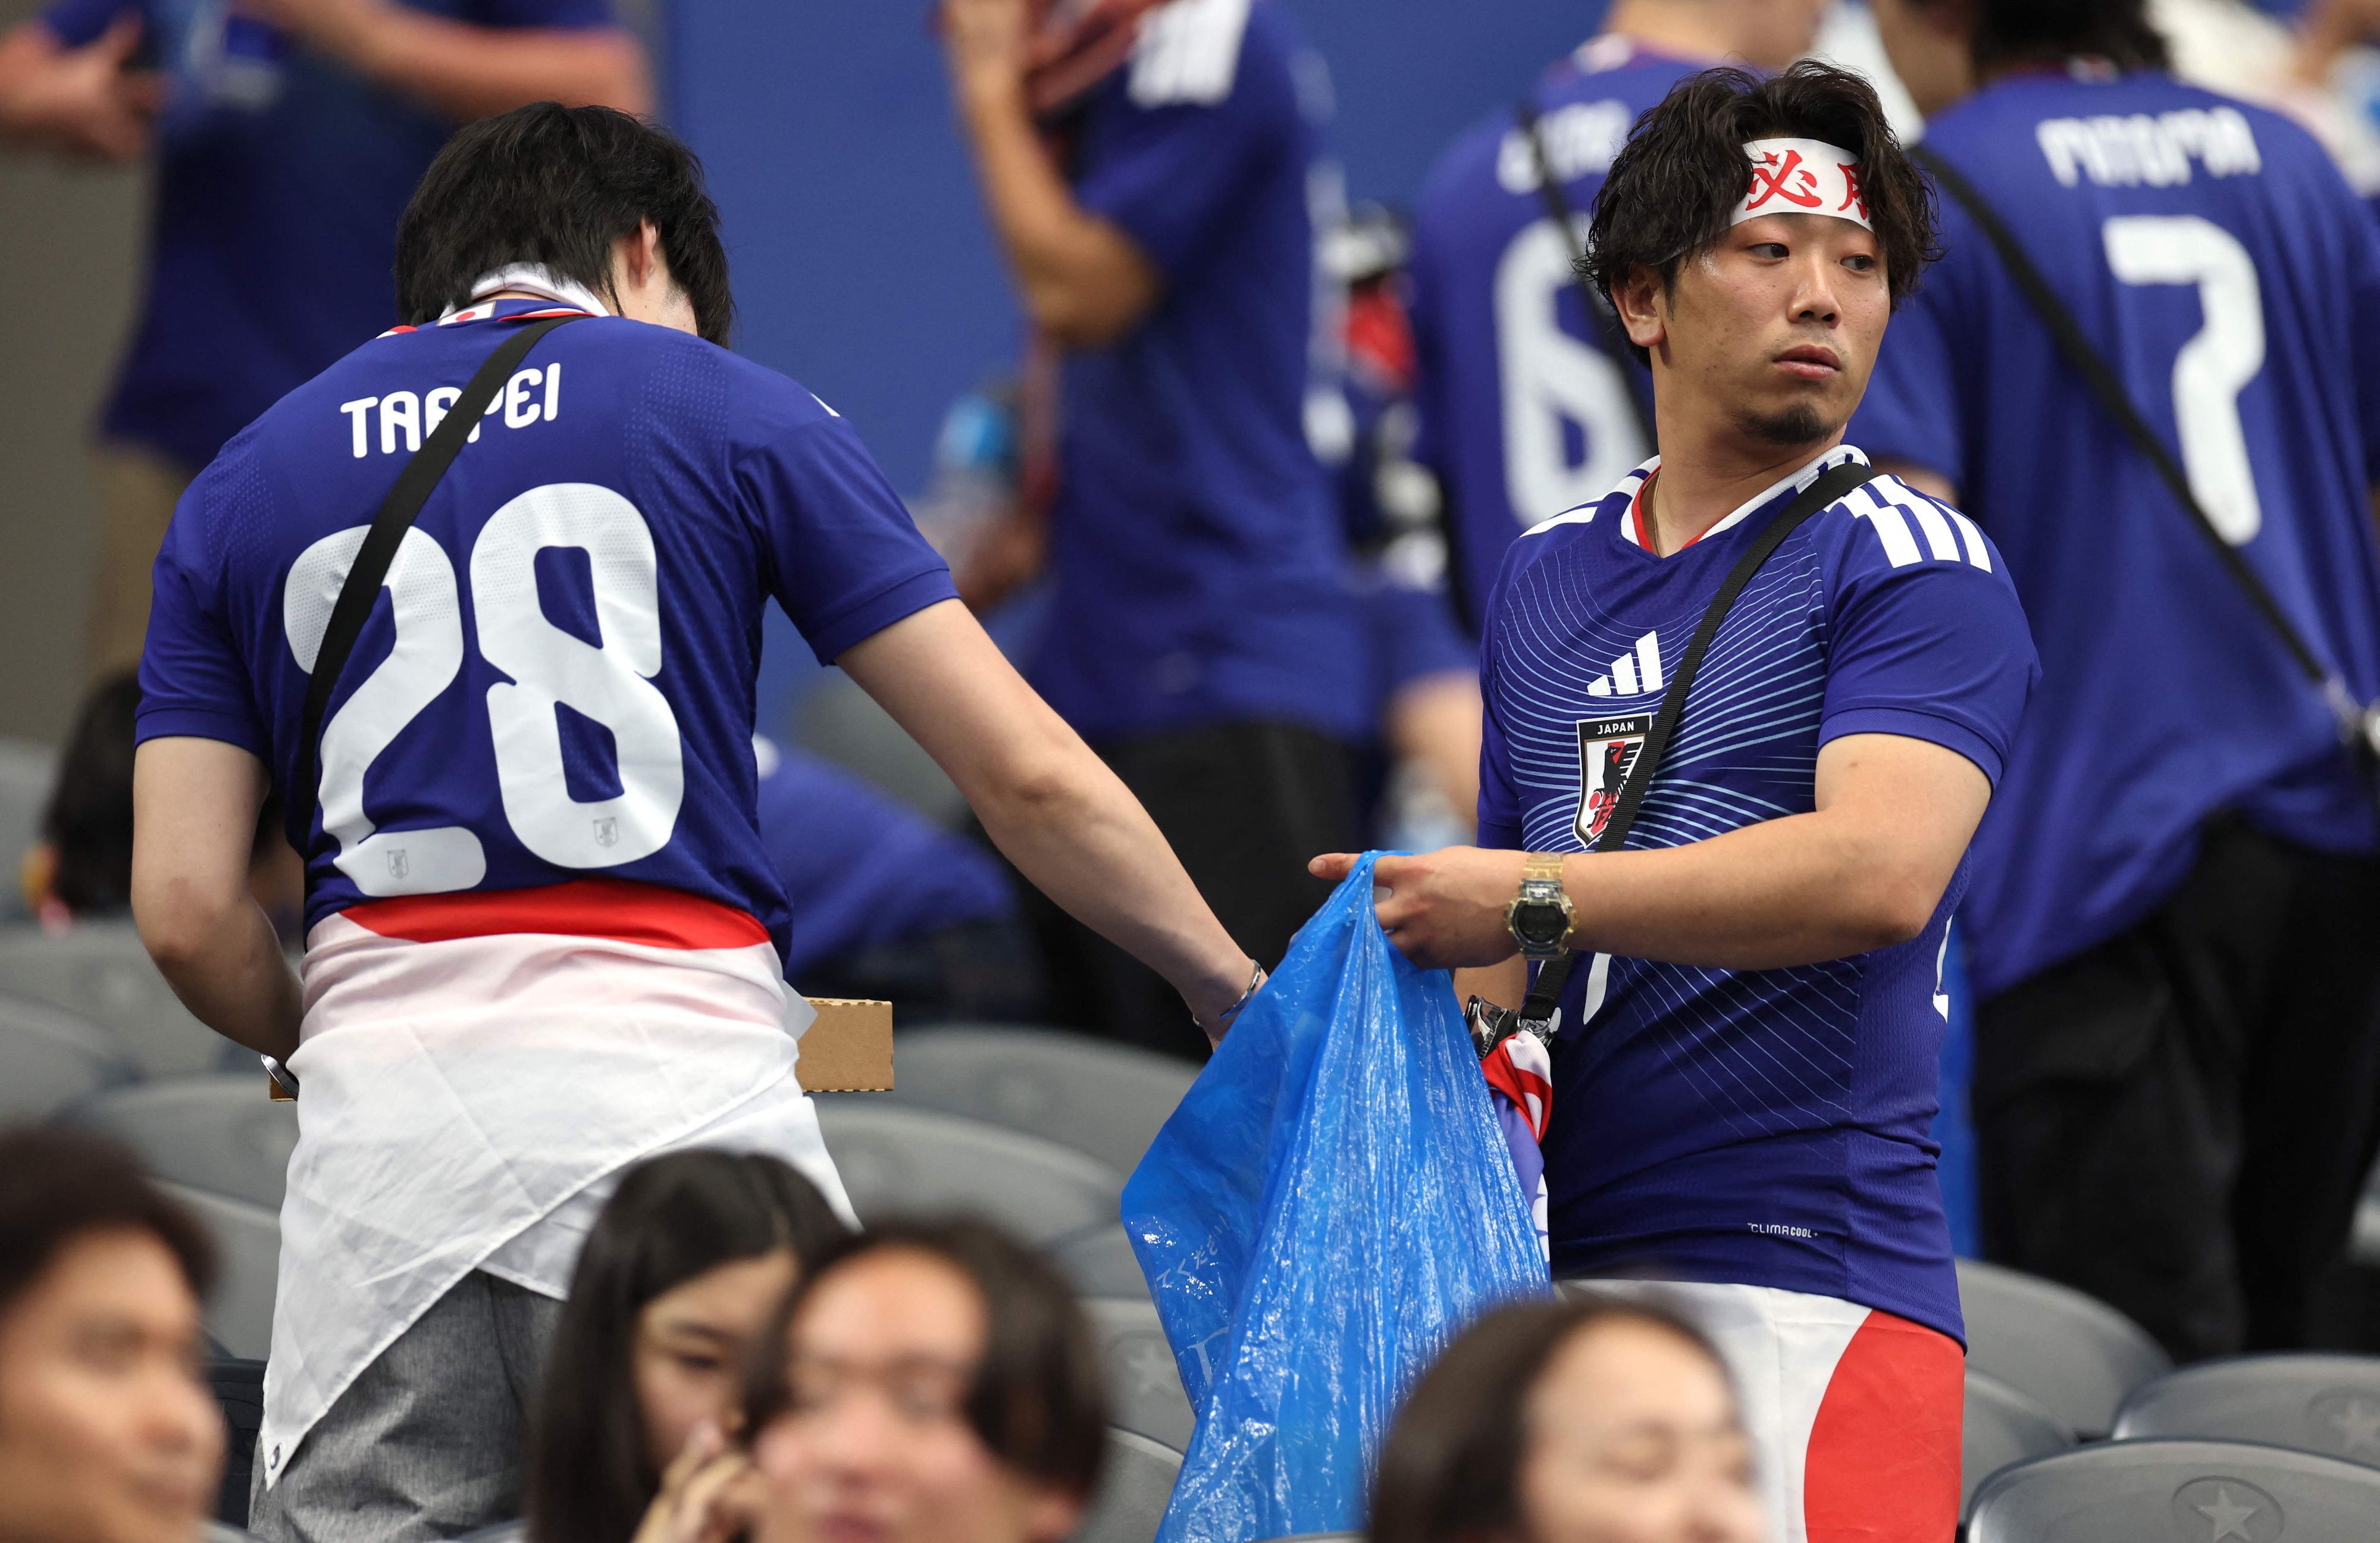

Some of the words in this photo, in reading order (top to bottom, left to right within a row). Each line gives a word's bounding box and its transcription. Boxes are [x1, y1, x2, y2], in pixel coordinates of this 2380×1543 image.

[2102, 213, 2267, 546] 7
[283, 482, 685, 898] 28
[1597, 721, 1634, 735] JAPAN
